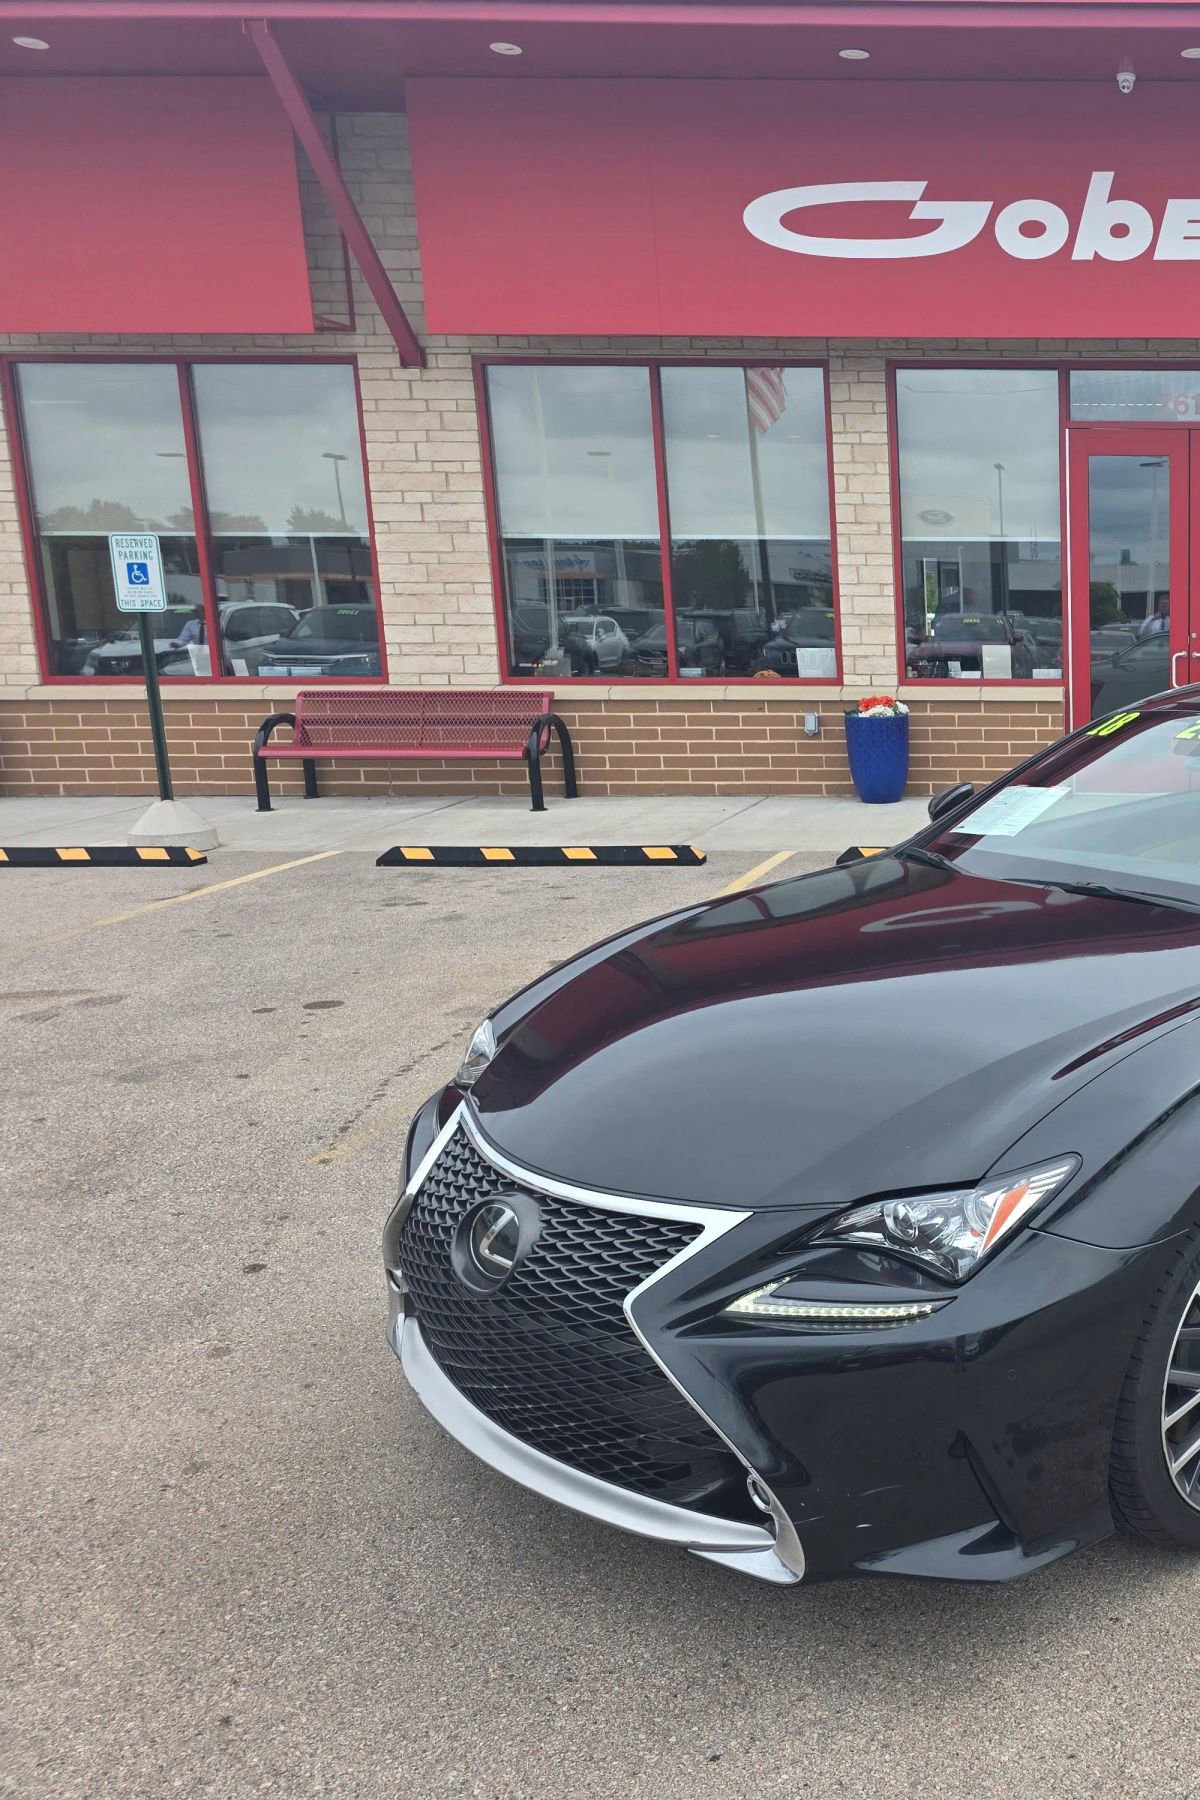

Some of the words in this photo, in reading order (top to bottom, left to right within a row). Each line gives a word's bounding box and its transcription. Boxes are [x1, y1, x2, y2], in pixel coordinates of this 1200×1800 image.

[115, 538, 153, 548] RESERVED
[118, 551, 154, 560] PARKING
[1086, 712, 1140, 736] 18
